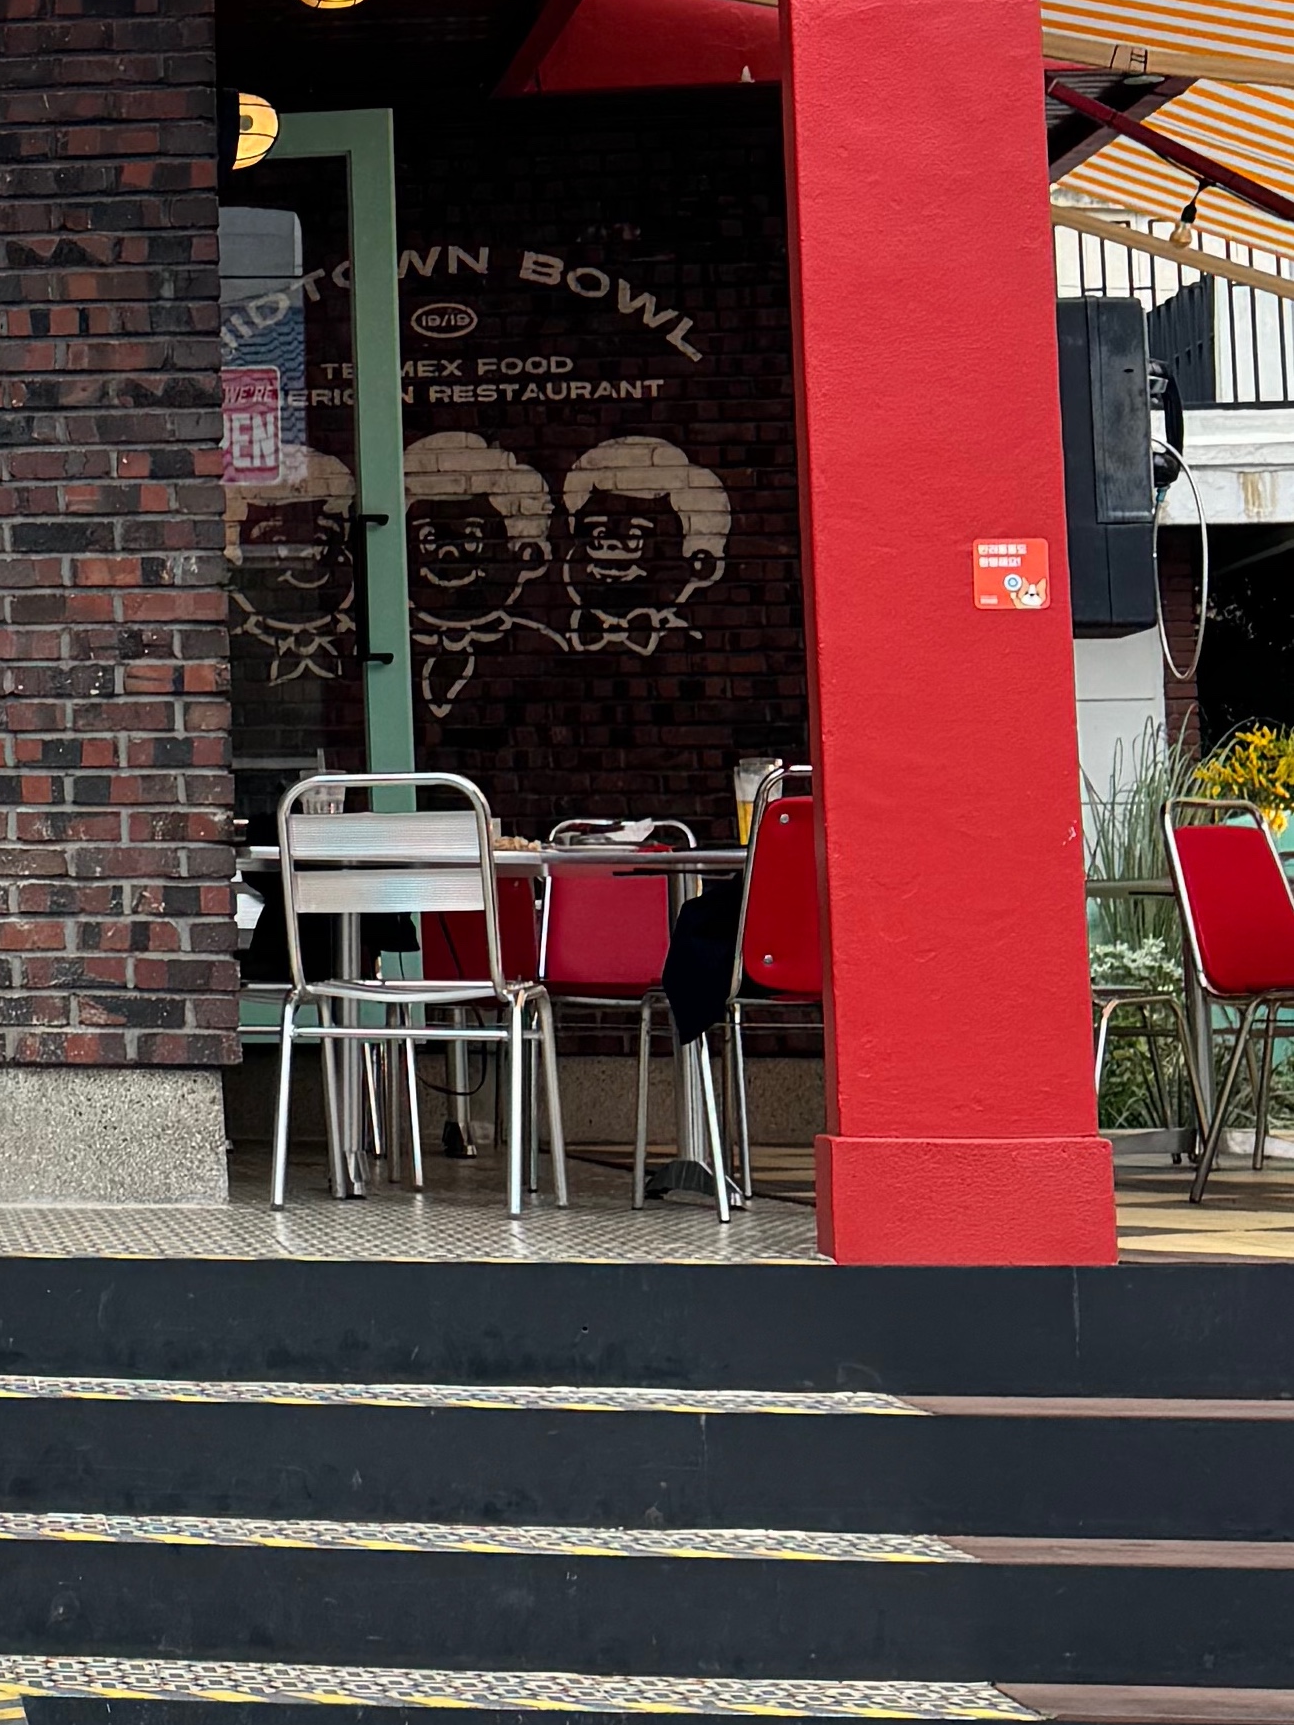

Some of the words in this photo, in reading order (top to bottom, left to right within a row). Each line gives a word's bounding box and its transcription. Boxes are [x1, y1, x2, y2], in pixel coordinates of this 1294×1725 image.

[519, 249, 703, 363] BOWL
[478, 355, 574, 377] FOOD
[428, 379, 665, 404] RESTAURANT
